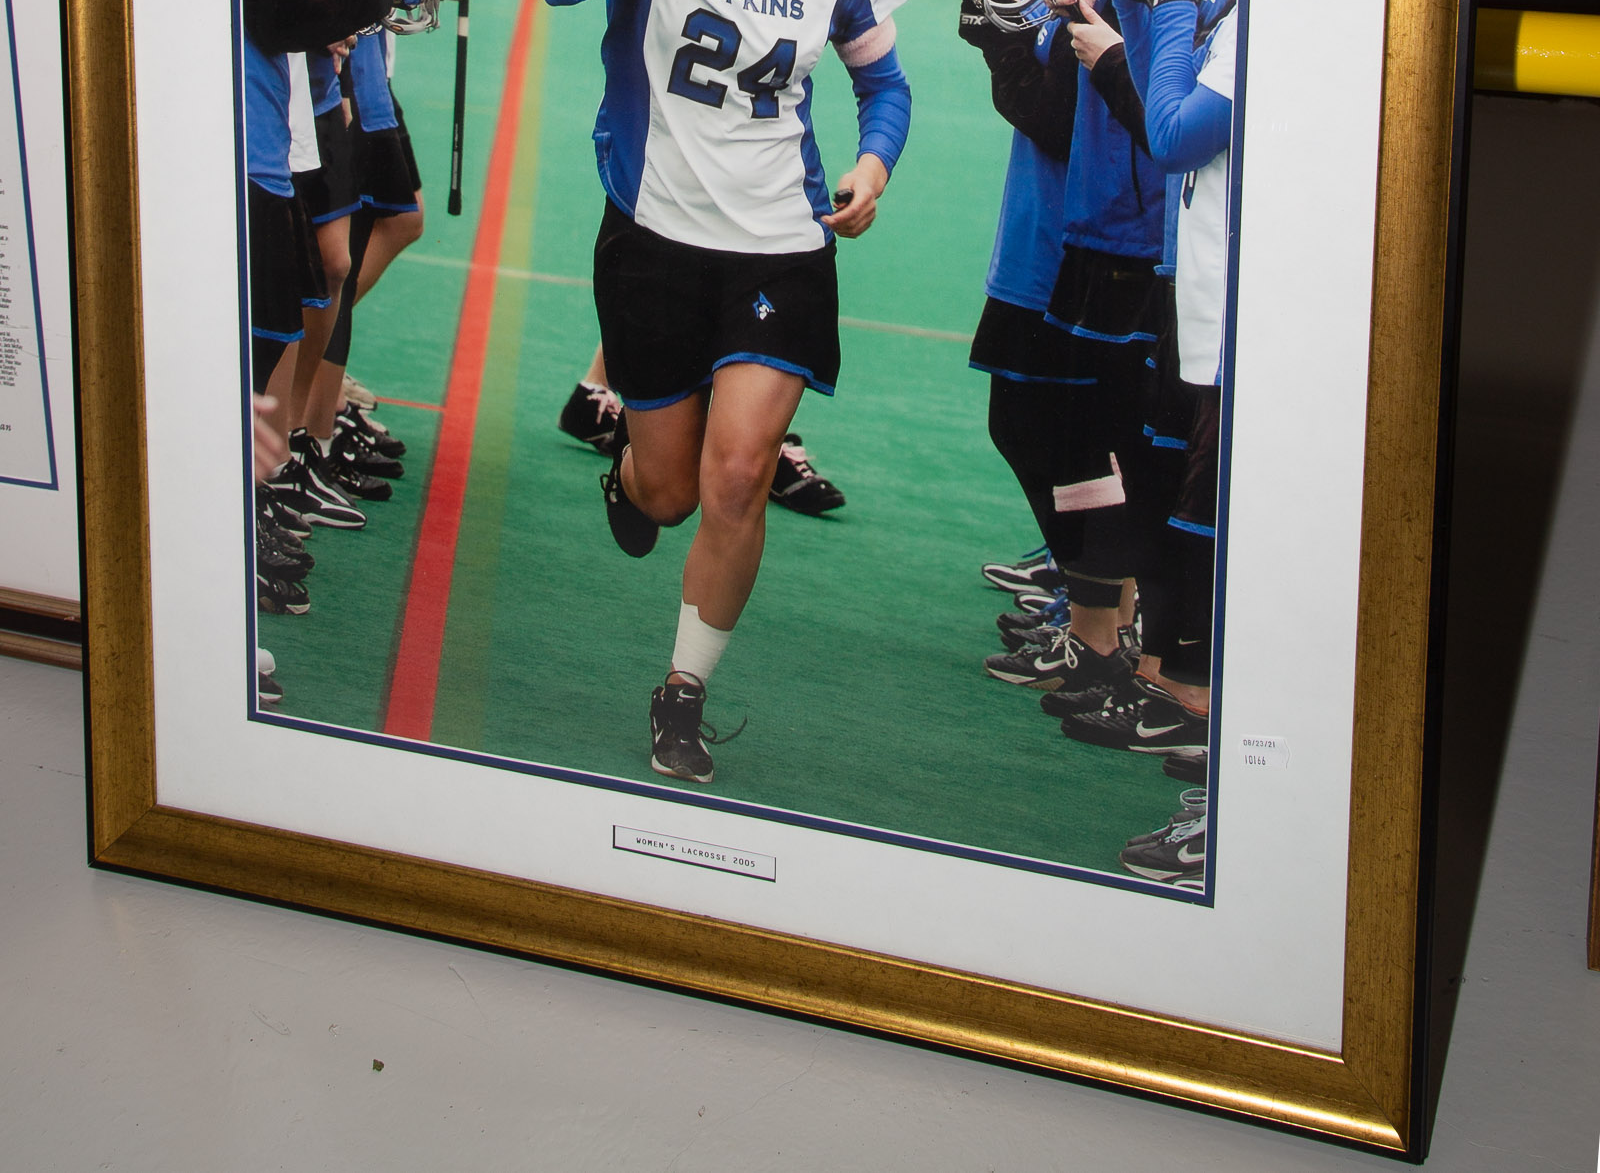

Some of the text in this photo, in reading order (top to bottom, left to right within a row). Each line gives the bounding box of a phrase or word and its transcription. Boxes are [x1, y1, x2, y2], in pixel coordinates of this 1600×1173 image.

[961, 15, 985, 26] STX
[667, 7, 798, 119] 24
[1243, 739, 1276, 748] 08/23/21
[1244, 755, 1266, 766] 10166
[636, 837, 756, 868] WOMEN'S LACROSSE 2005
